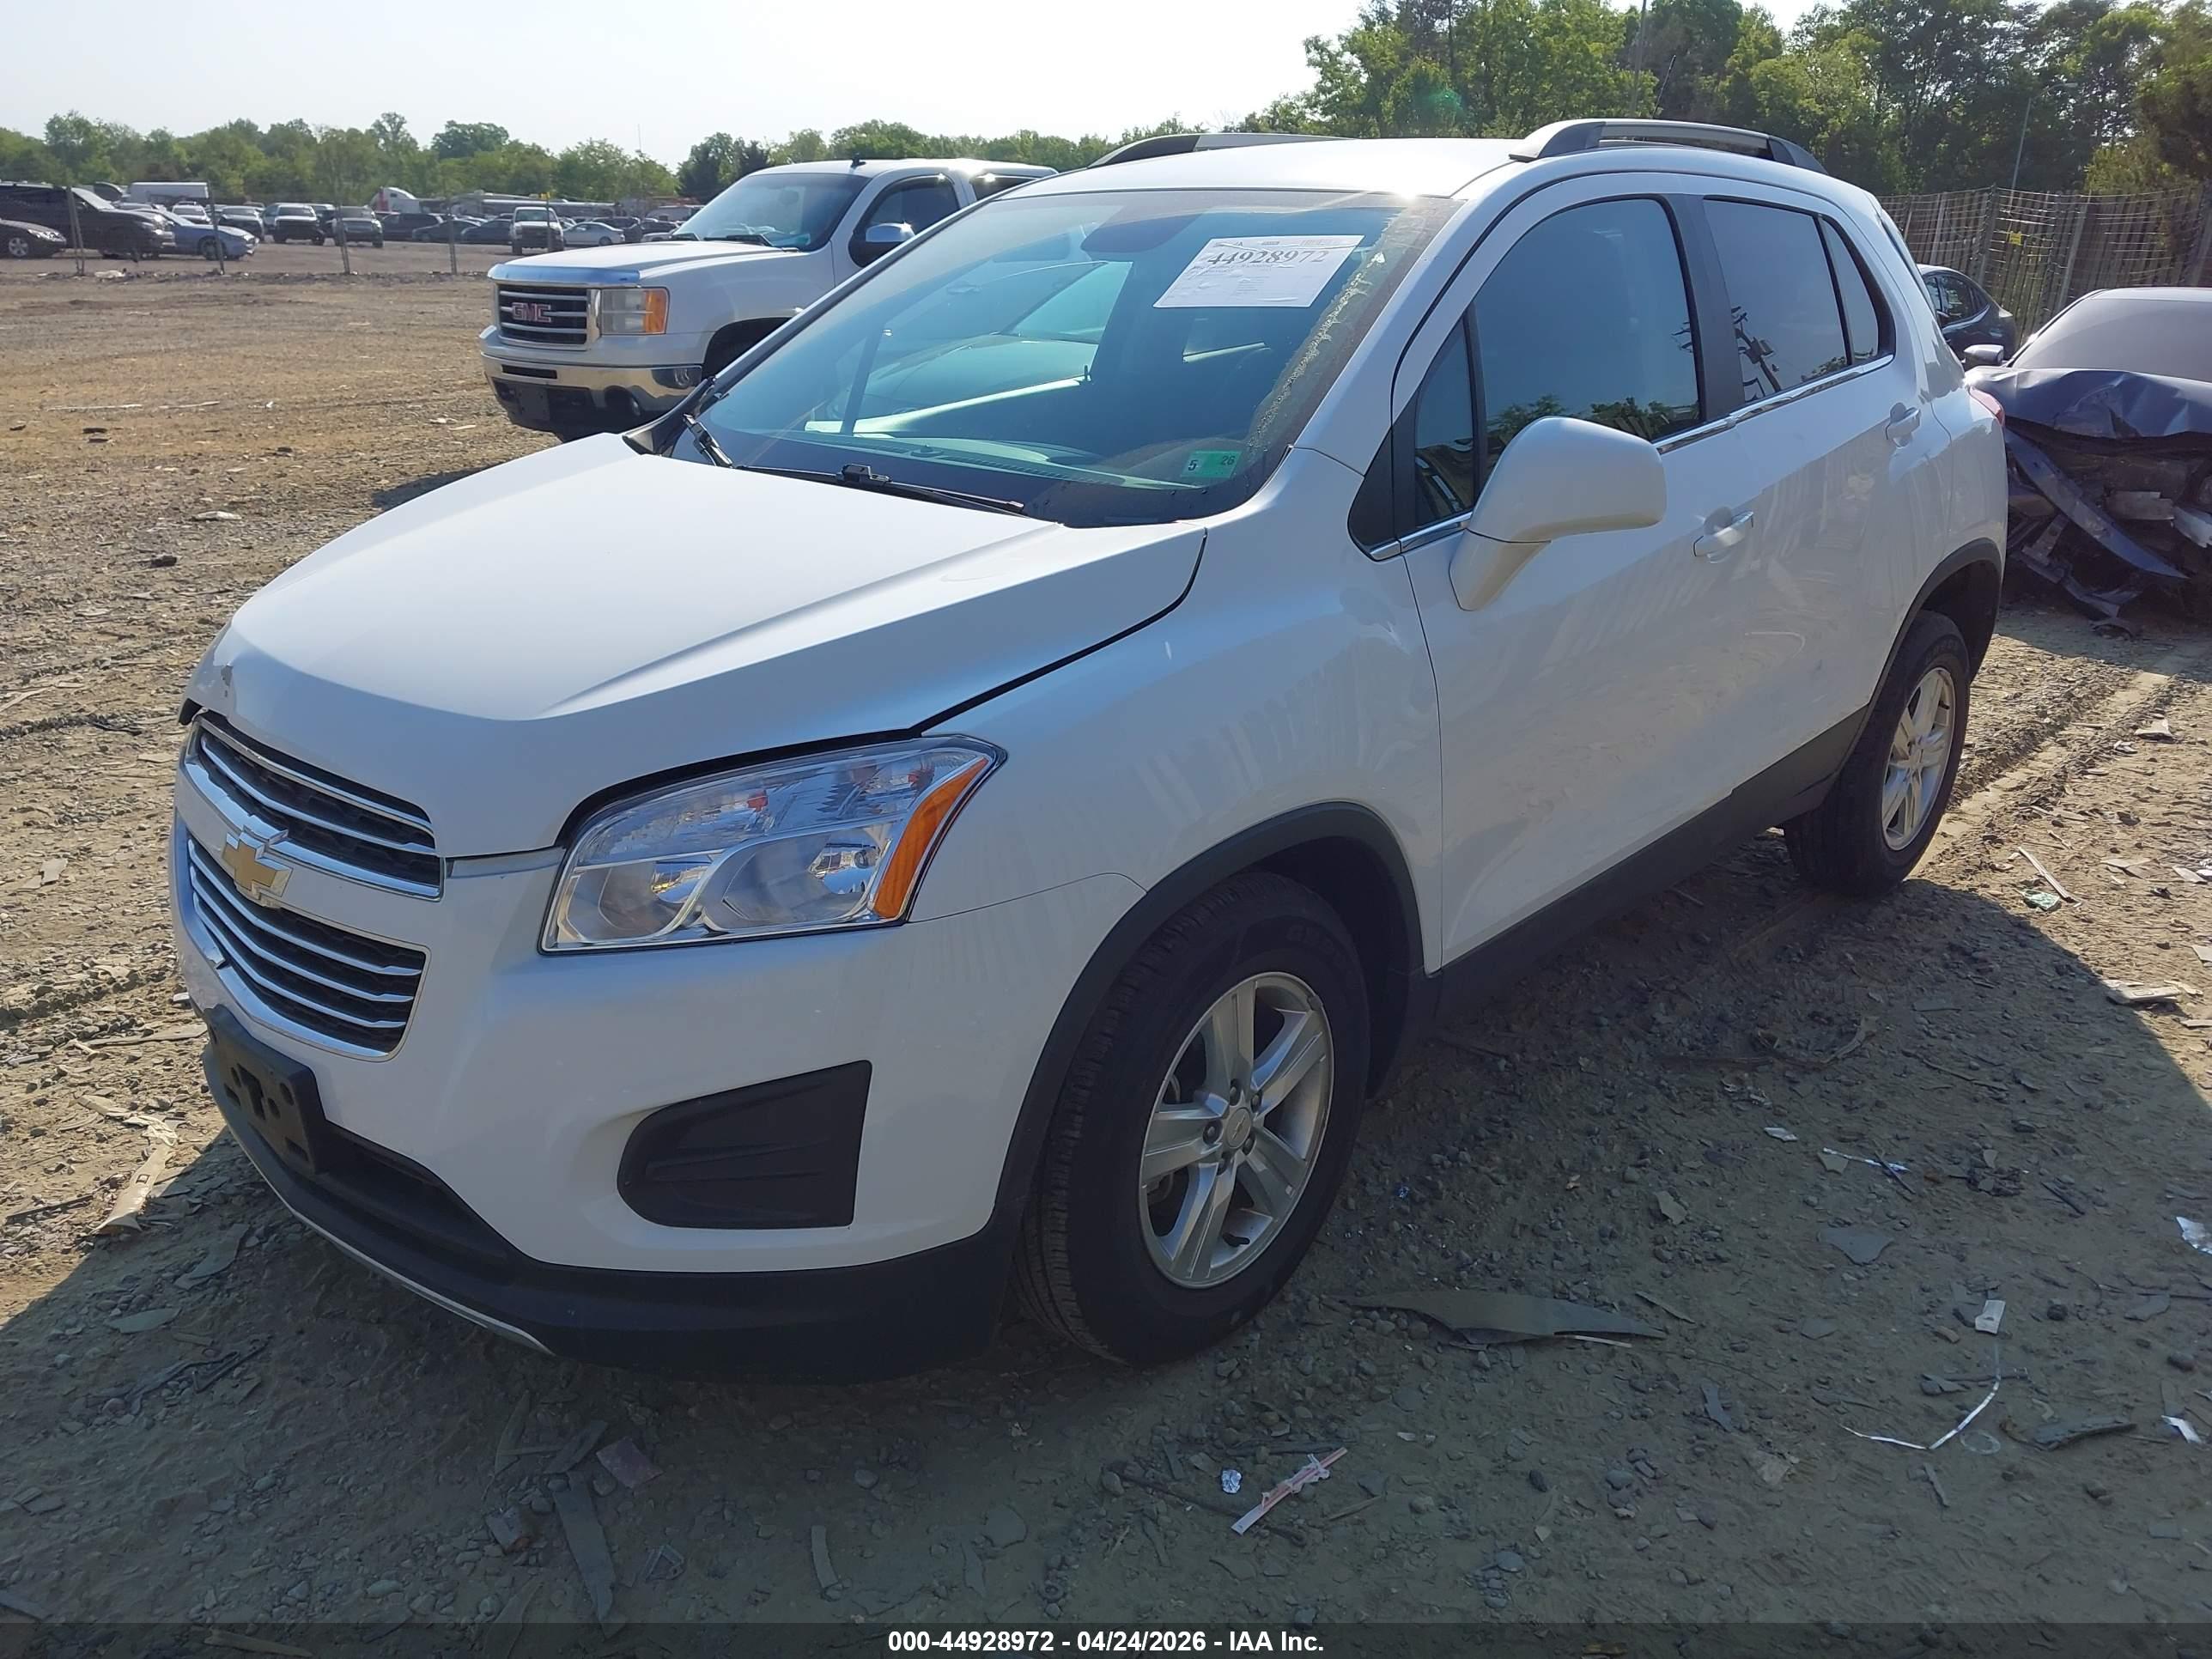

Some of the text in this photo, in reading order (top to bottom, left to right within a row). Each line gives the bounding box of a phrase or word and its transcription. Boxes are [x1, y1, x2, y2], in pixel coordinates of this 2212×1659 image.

[1207, 250, 1328, 264] 44928972
[512, 302, 551, 323] GMC
[1188, 455, 1236, 471] 5 26
